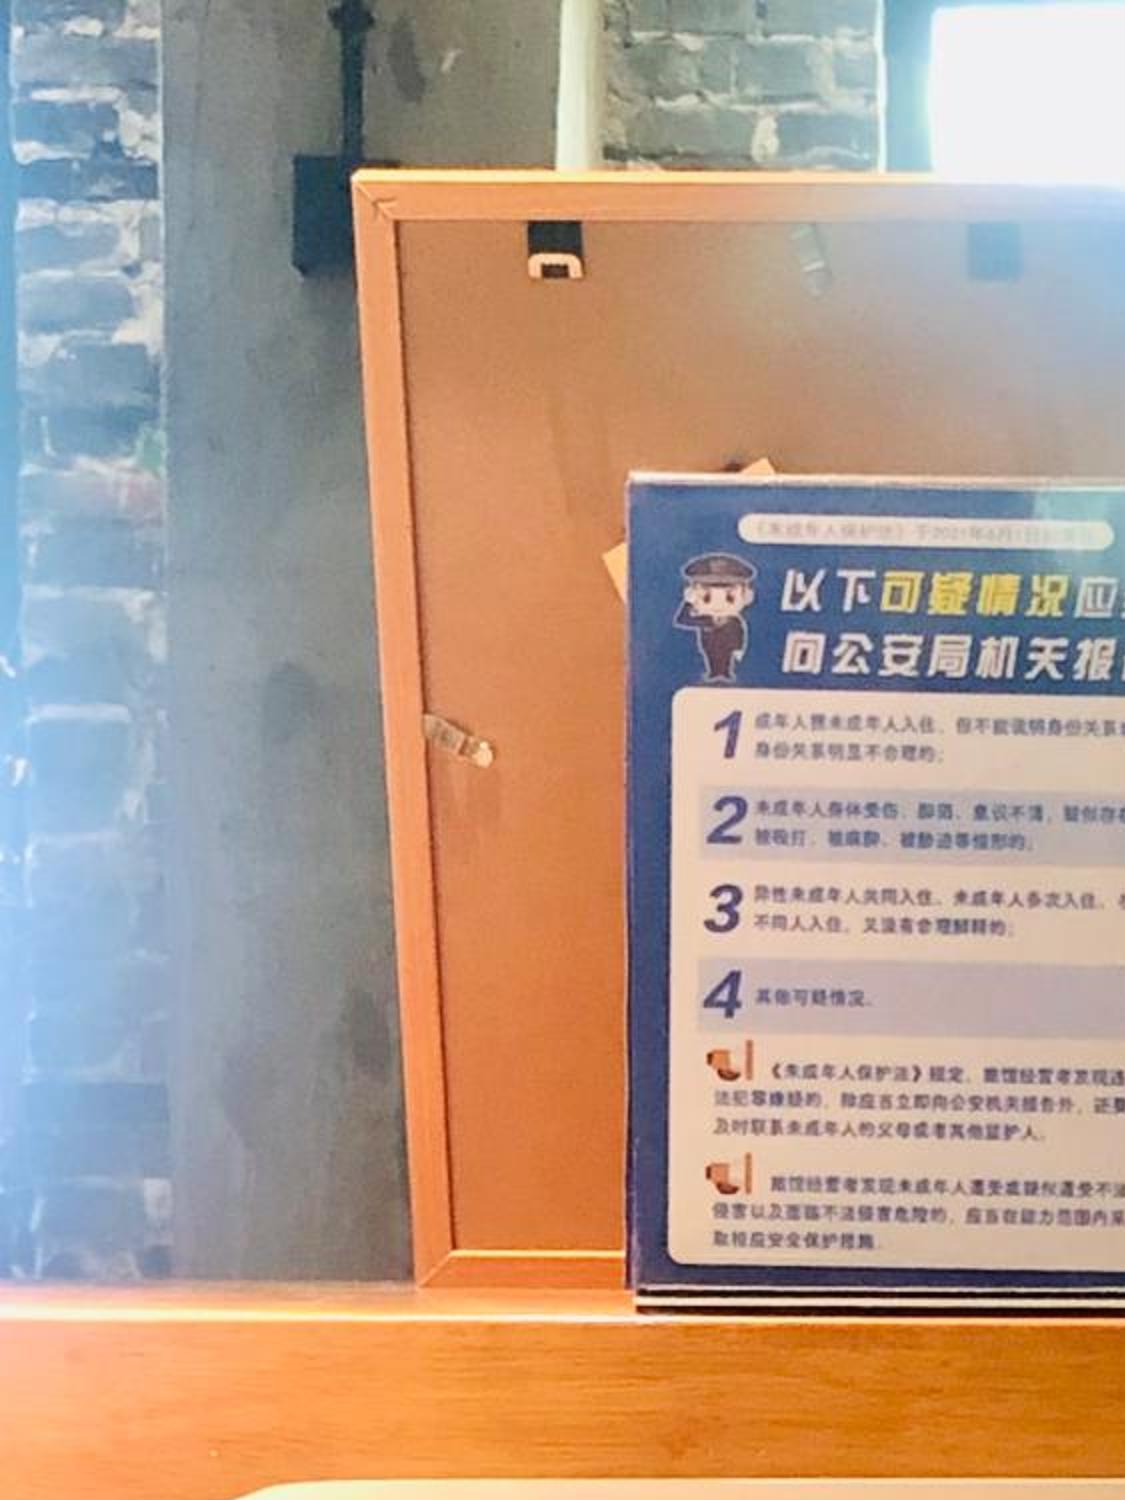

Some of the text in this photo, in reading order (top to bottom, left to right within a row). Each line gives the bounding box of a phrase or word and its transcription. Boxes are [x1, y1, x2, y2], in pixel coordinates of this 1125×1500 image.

[712, 709, 743, 759] 1
[706, 795, 748, 845] 2
[703, 883, 744, 934] 3
[703, 969, 743, 1019] 4
